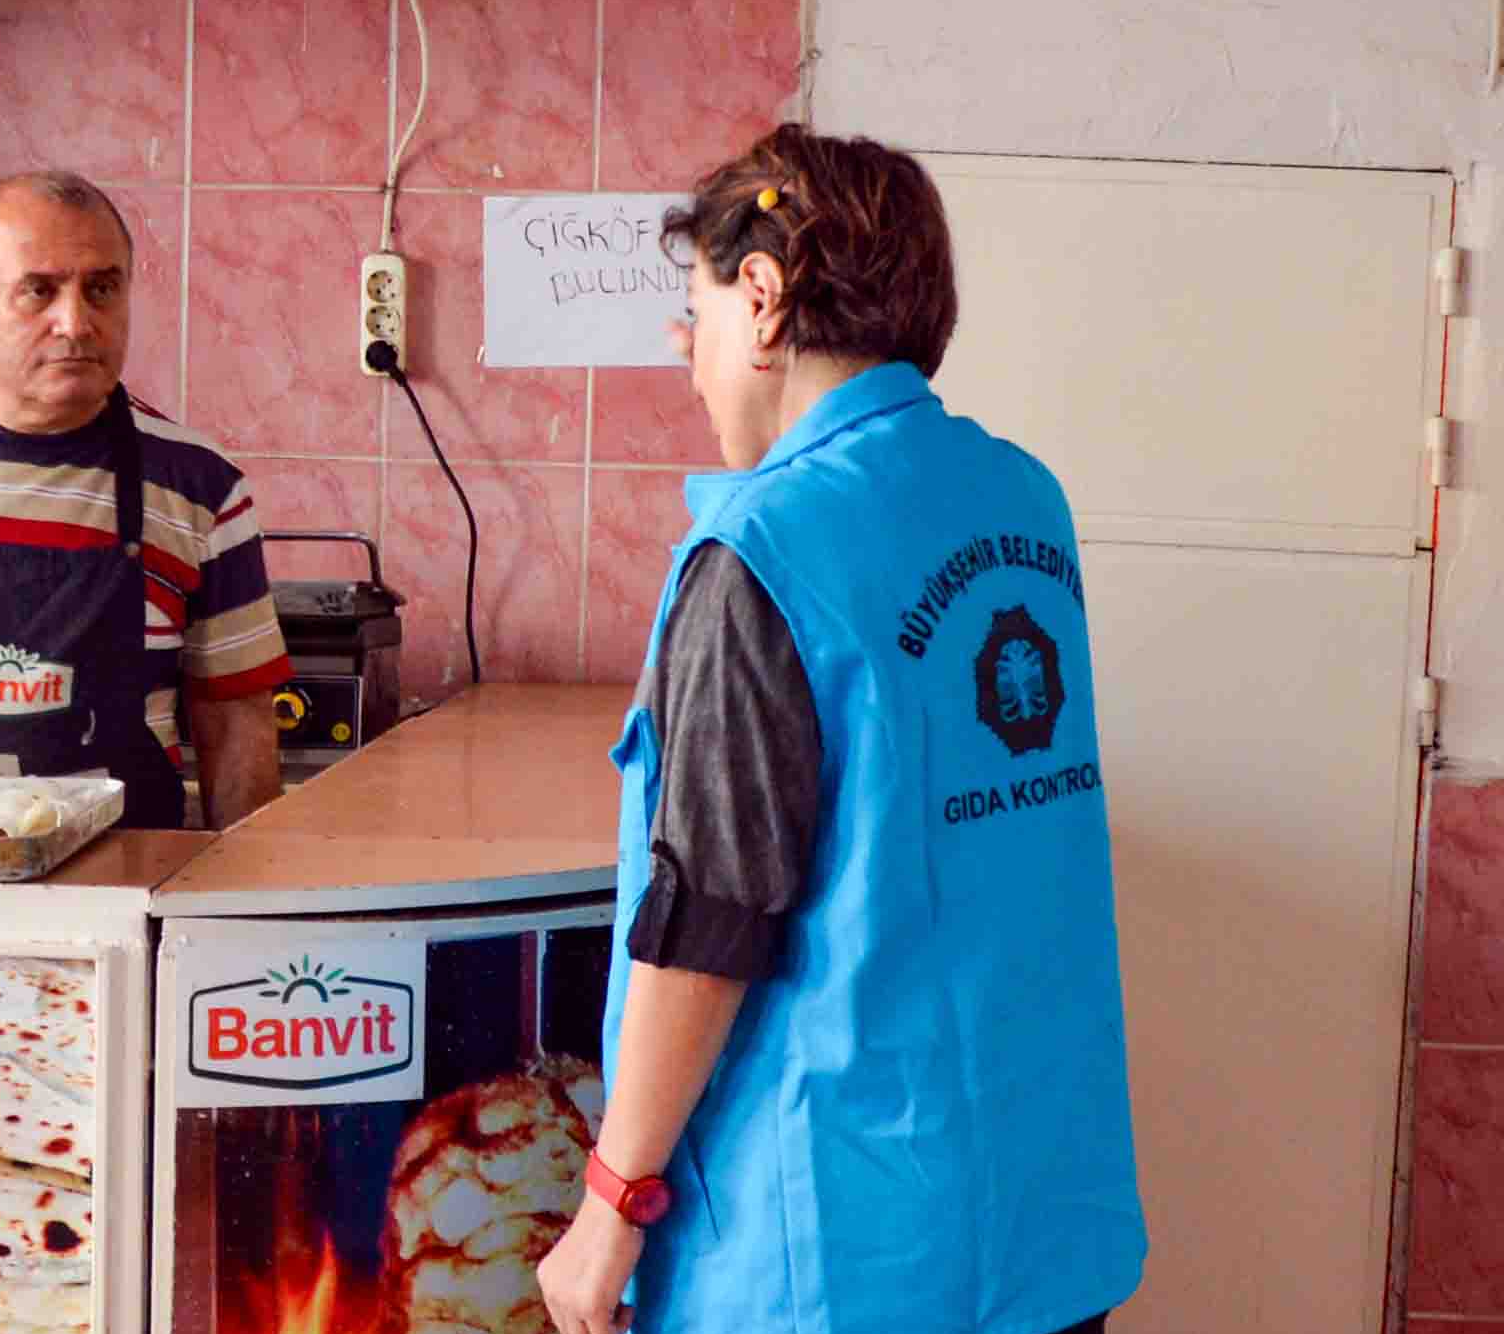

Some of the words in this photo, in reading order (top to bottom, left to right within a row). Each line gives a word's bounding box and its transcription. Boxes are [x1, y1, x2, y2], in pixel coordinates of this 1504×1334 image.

[524, 205, 652, 258] ÇİĞKÖF
[549, 266, 690, 307] BULUNU
[897, 534, 994, 660] BÜYÜKŞEHİR
[943, 786, 1008, 825] GIDA
[207, 1000, 396, 1060] Banvit
